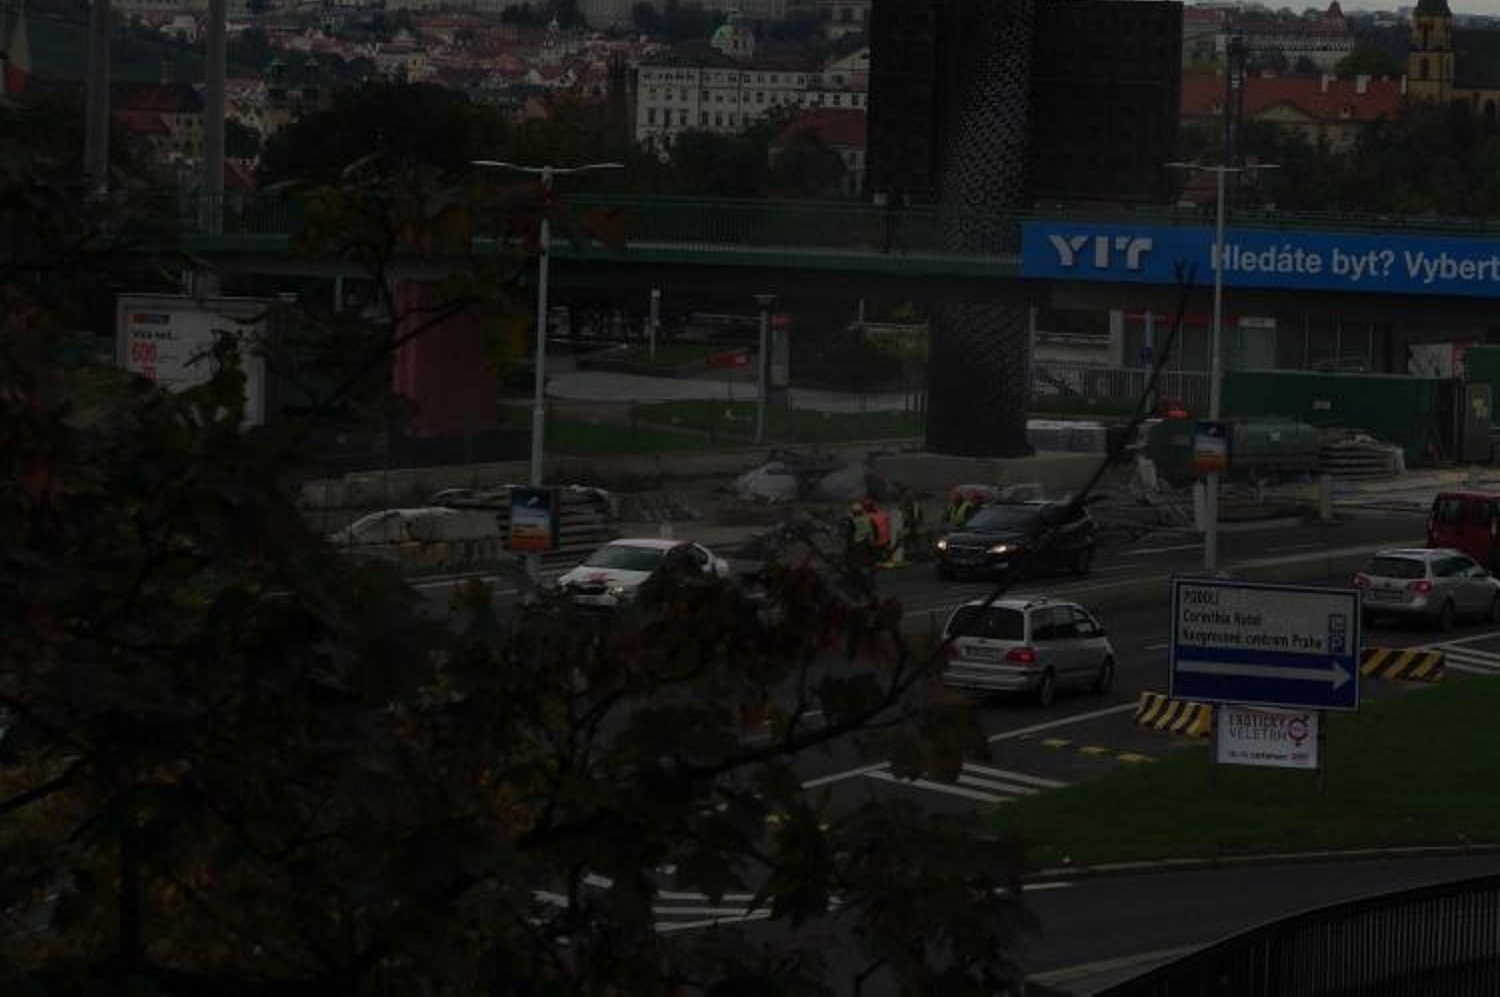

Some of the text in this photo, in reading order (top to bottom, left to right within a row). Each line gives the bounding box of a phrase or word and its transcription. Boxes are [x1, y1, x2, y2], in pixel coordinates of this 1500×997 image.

[1048, 234, 1152, 271] YIT
[1211, 244, 1323, 274] Hledáte
[1332, 248, 1395, 281] byt?
